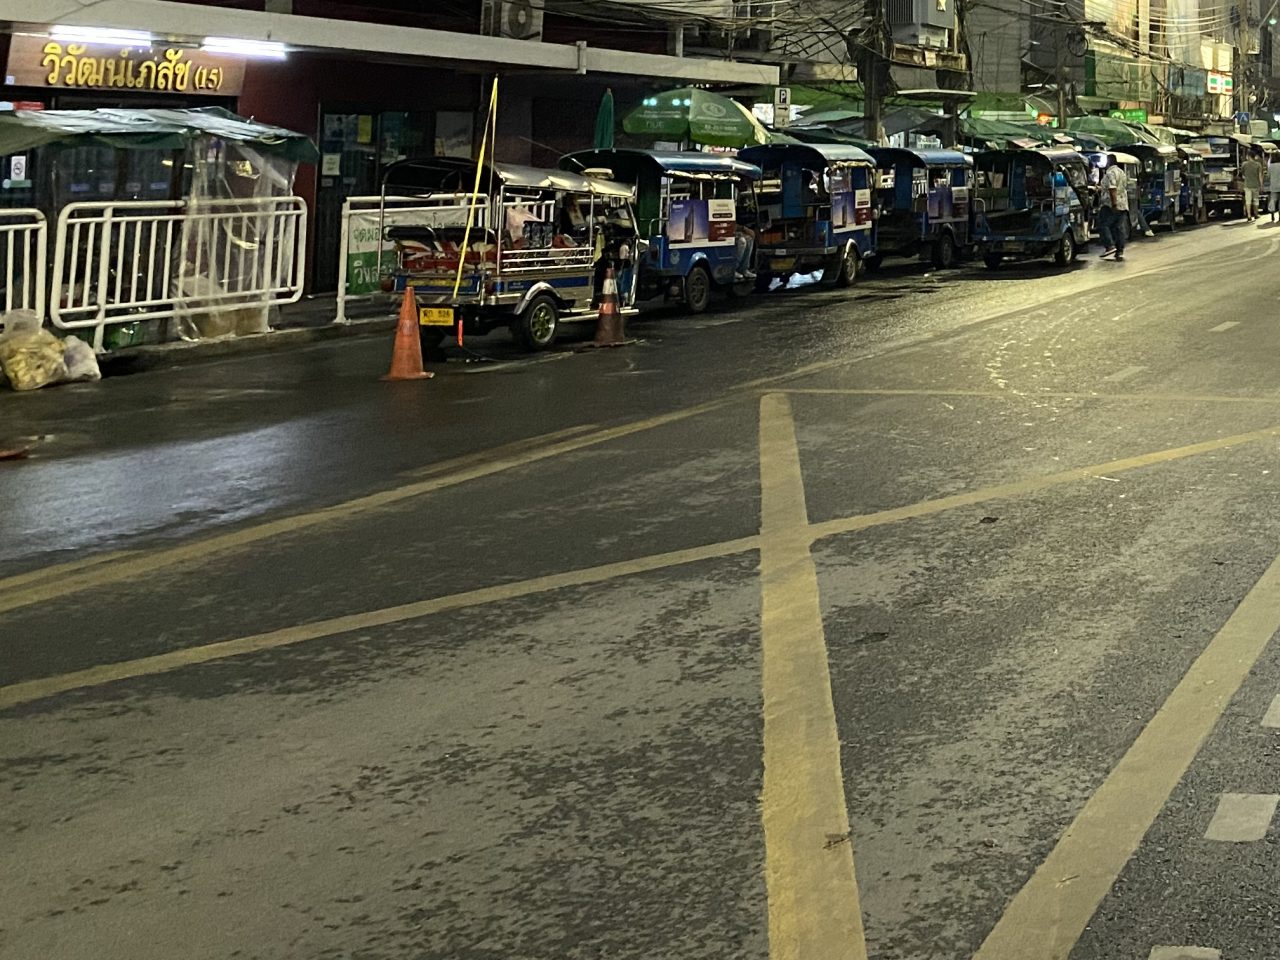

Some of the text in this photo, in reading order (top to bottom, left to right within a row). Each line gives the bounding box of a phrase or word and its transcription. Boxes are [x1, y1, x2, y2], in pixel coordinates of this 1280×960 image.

[42, 42, 223, 91] วิวัฒน์เภสัช (15)
